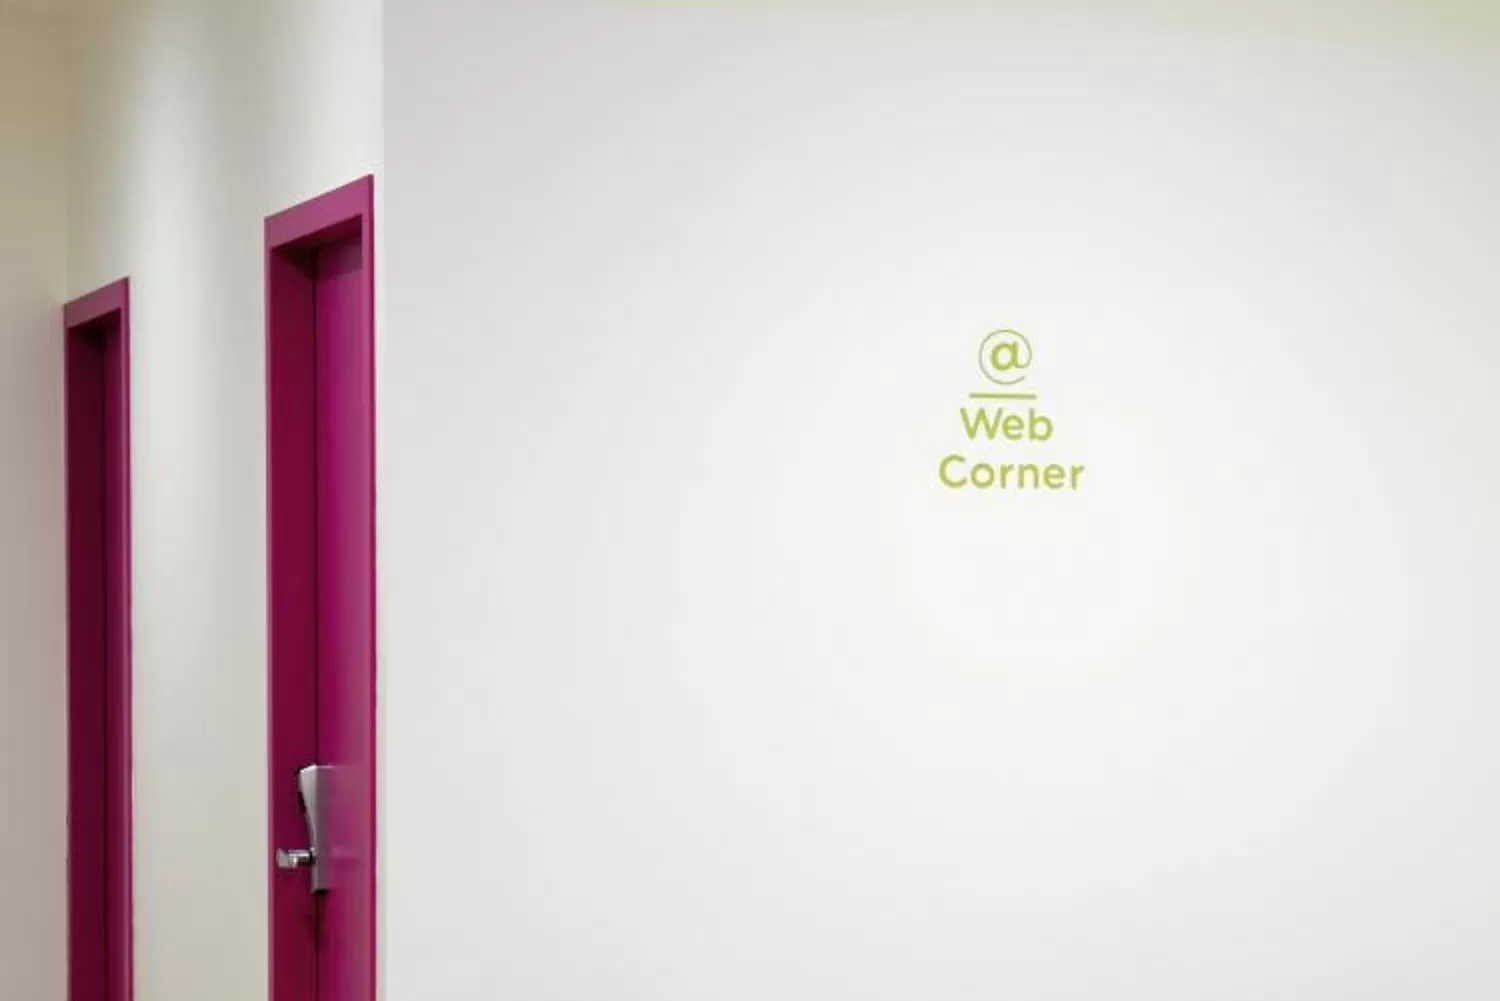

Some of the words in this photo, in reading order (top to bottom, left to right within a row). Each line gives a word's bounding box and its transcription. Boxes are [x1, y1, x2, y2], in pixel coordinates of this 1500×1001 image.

[979, 329, 1033, 385] @
[959, 407, 1053, 441] Web
[939, 454, 1085, 490] Corner
